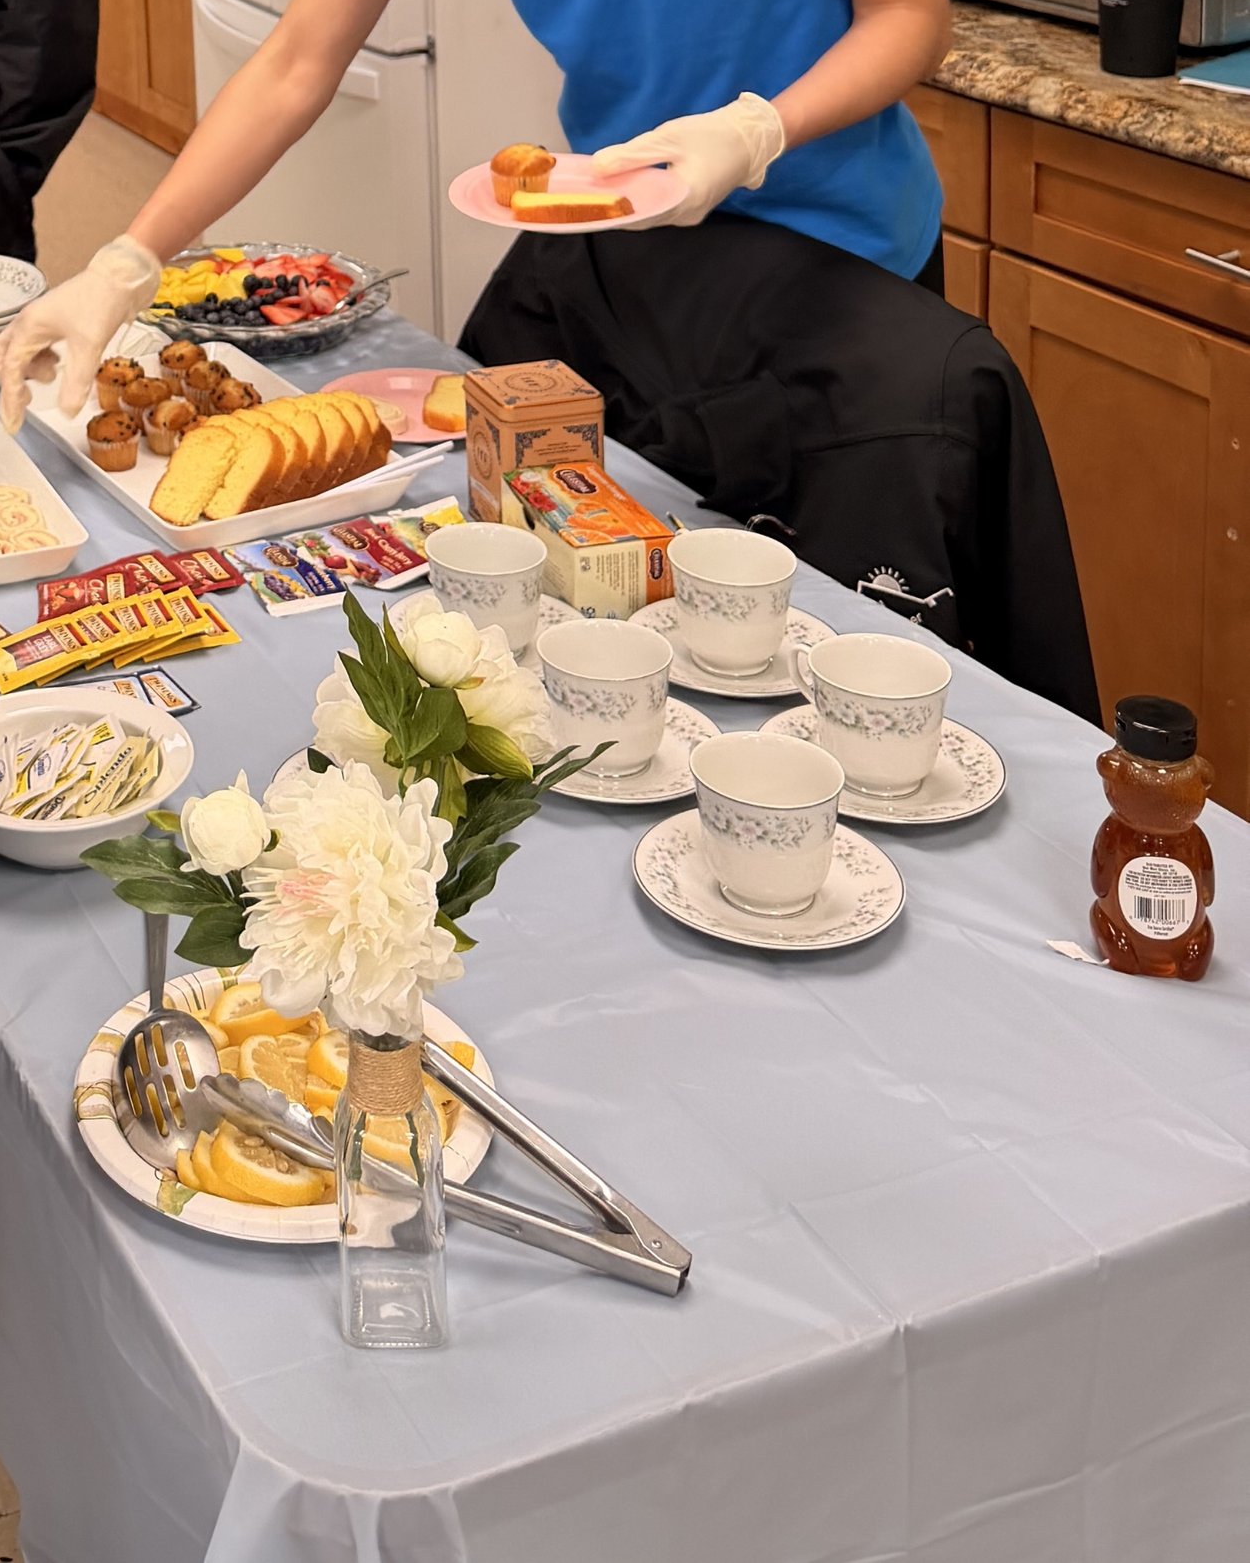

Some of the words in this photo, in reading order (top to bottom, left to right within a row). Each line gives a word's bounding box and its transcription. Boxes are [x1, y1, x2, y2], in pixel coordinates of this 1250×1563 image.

[125, 563, 152, 585] Chai
[180, 559, 206, 582] Chai
[88, 578, 104, 604] Chai
[120, 605, 140, 632] TWININGS
[172, 598, 191, 623] TWININGS
[54, 624, 77, 651] TWININGS
[86, 614, 110, 639] TWININGS
[150, 676, 178, 703] TWININGS
